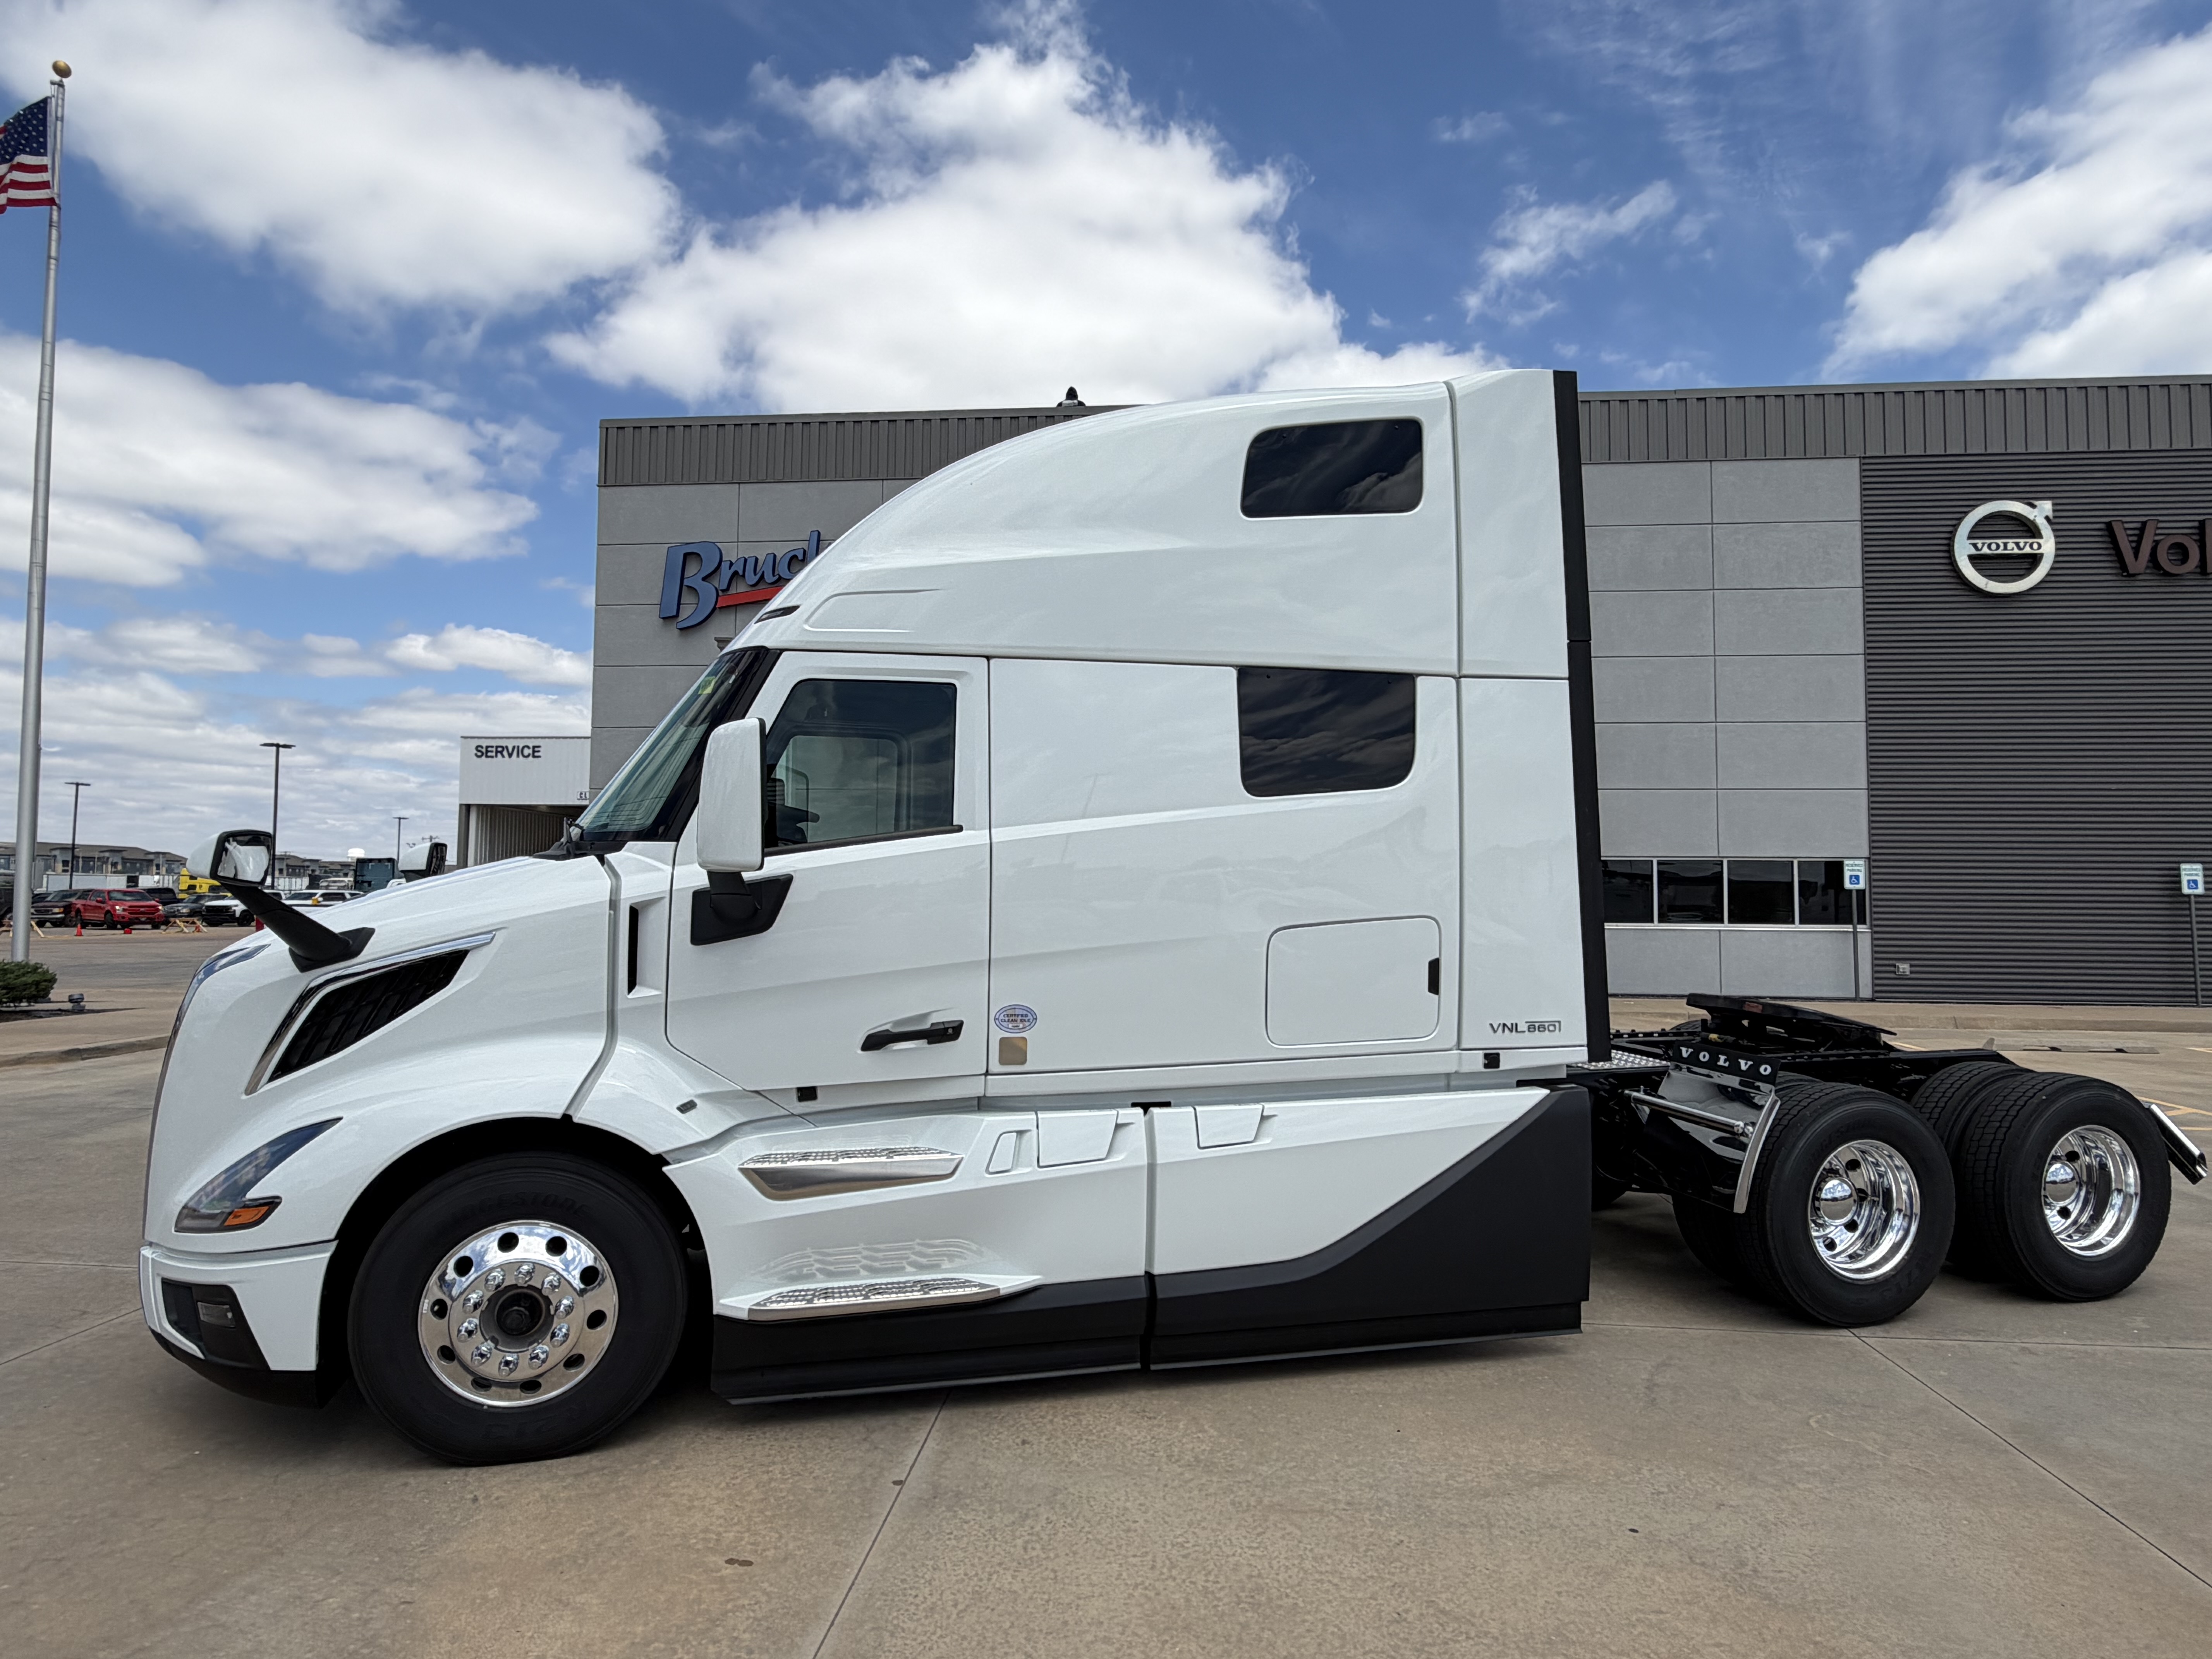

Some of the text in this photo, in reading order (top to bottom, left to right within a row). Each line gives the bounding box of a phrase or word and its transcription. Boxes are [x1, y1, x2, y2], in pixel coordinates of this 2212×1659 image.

[1968, 541, 2042, 552] VOLVO
[474, 745, 541, 758] SERVICE
[1679, 1046, 1772, 1076] VOLVO
